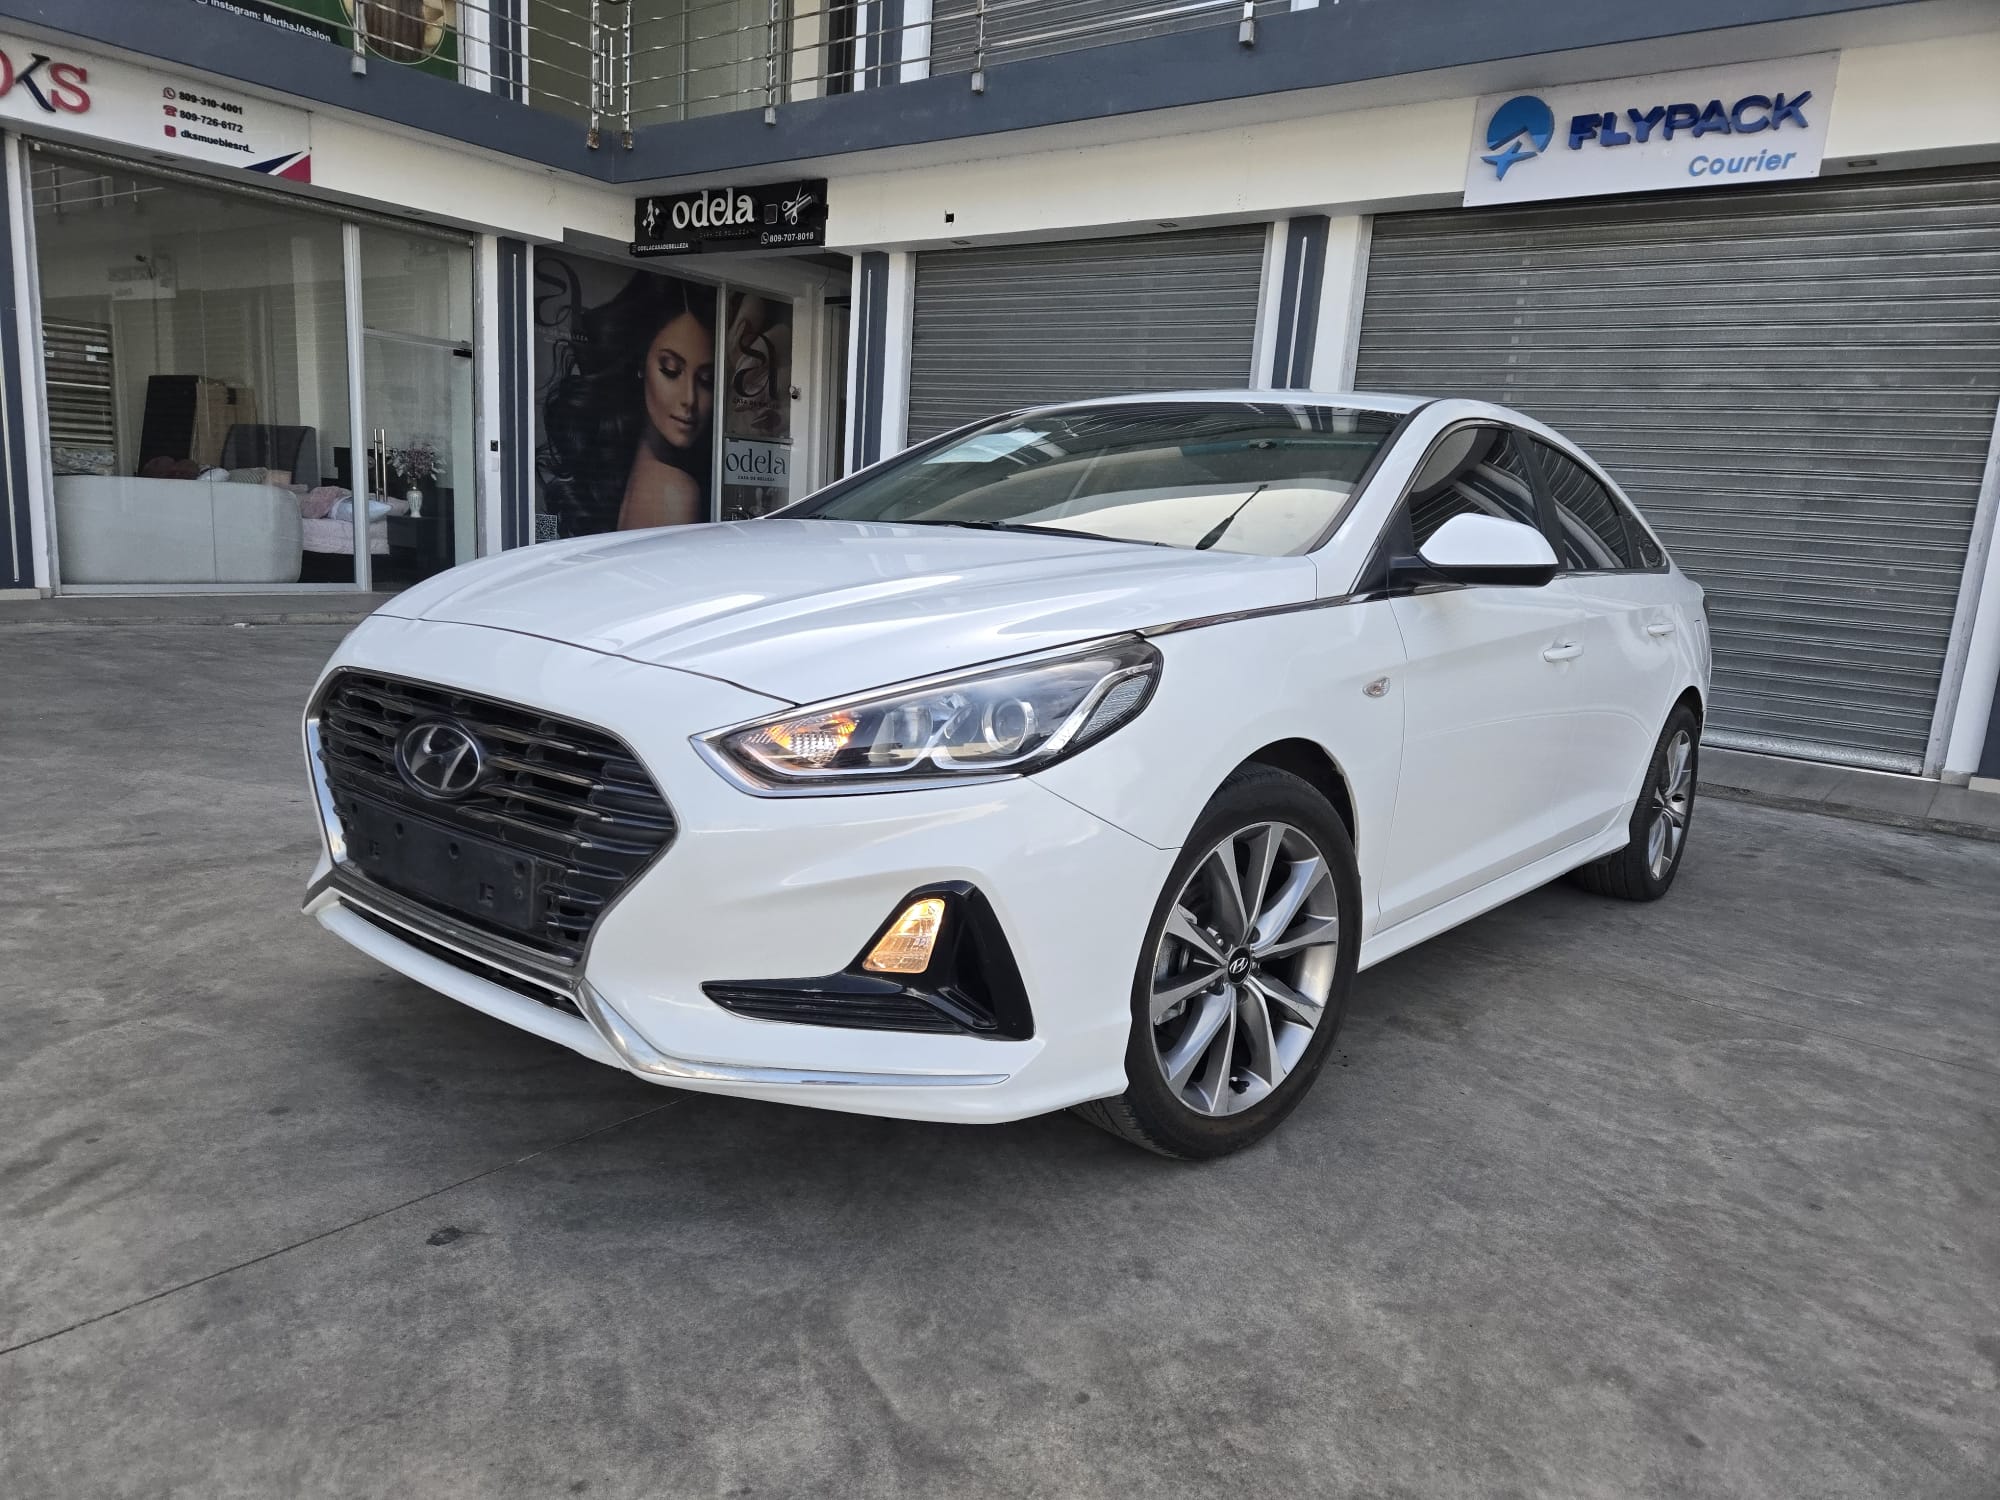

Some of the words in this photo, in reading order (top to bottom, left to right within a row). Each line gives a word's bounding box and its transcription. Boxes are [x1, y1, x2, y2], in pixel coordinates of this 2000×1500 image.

[263, 13, 332, 42] MarthaJASalon
[179, 91, 243, 115] 809-310-4001
[179, 110, 243, 133] 809-726-6172
[1568, 90, 1813, 150] FLYPACK
[1688, 149, 1797, 177] Courier
[672, 187, 755, 229] odela
[769, 231, 814, 243] 809-707-8018
[726, 448, 787, 475] odela
